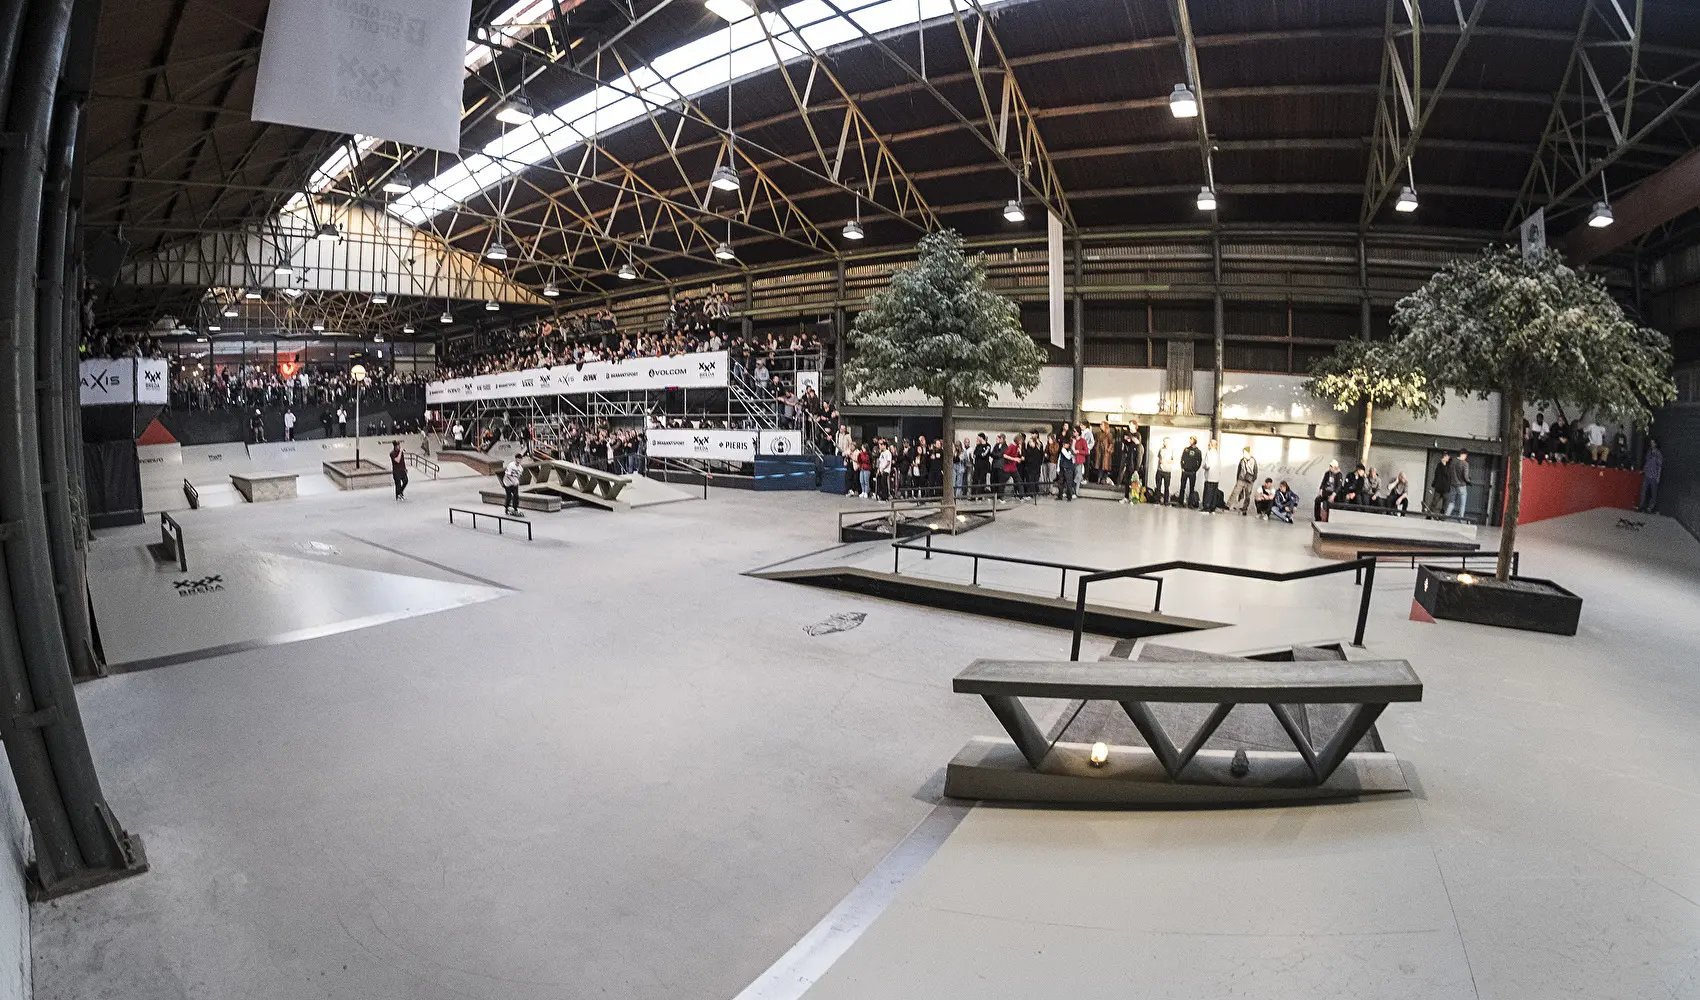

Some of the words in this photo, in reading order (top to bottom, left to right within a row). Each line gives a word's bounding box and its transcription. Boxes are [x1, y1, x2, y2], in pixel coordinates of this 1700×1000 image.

[655, 368, 687, 376] VOLCOM
[79, 368, 120, 394] AXIS
[178, 583, 226, 598] BREDA
